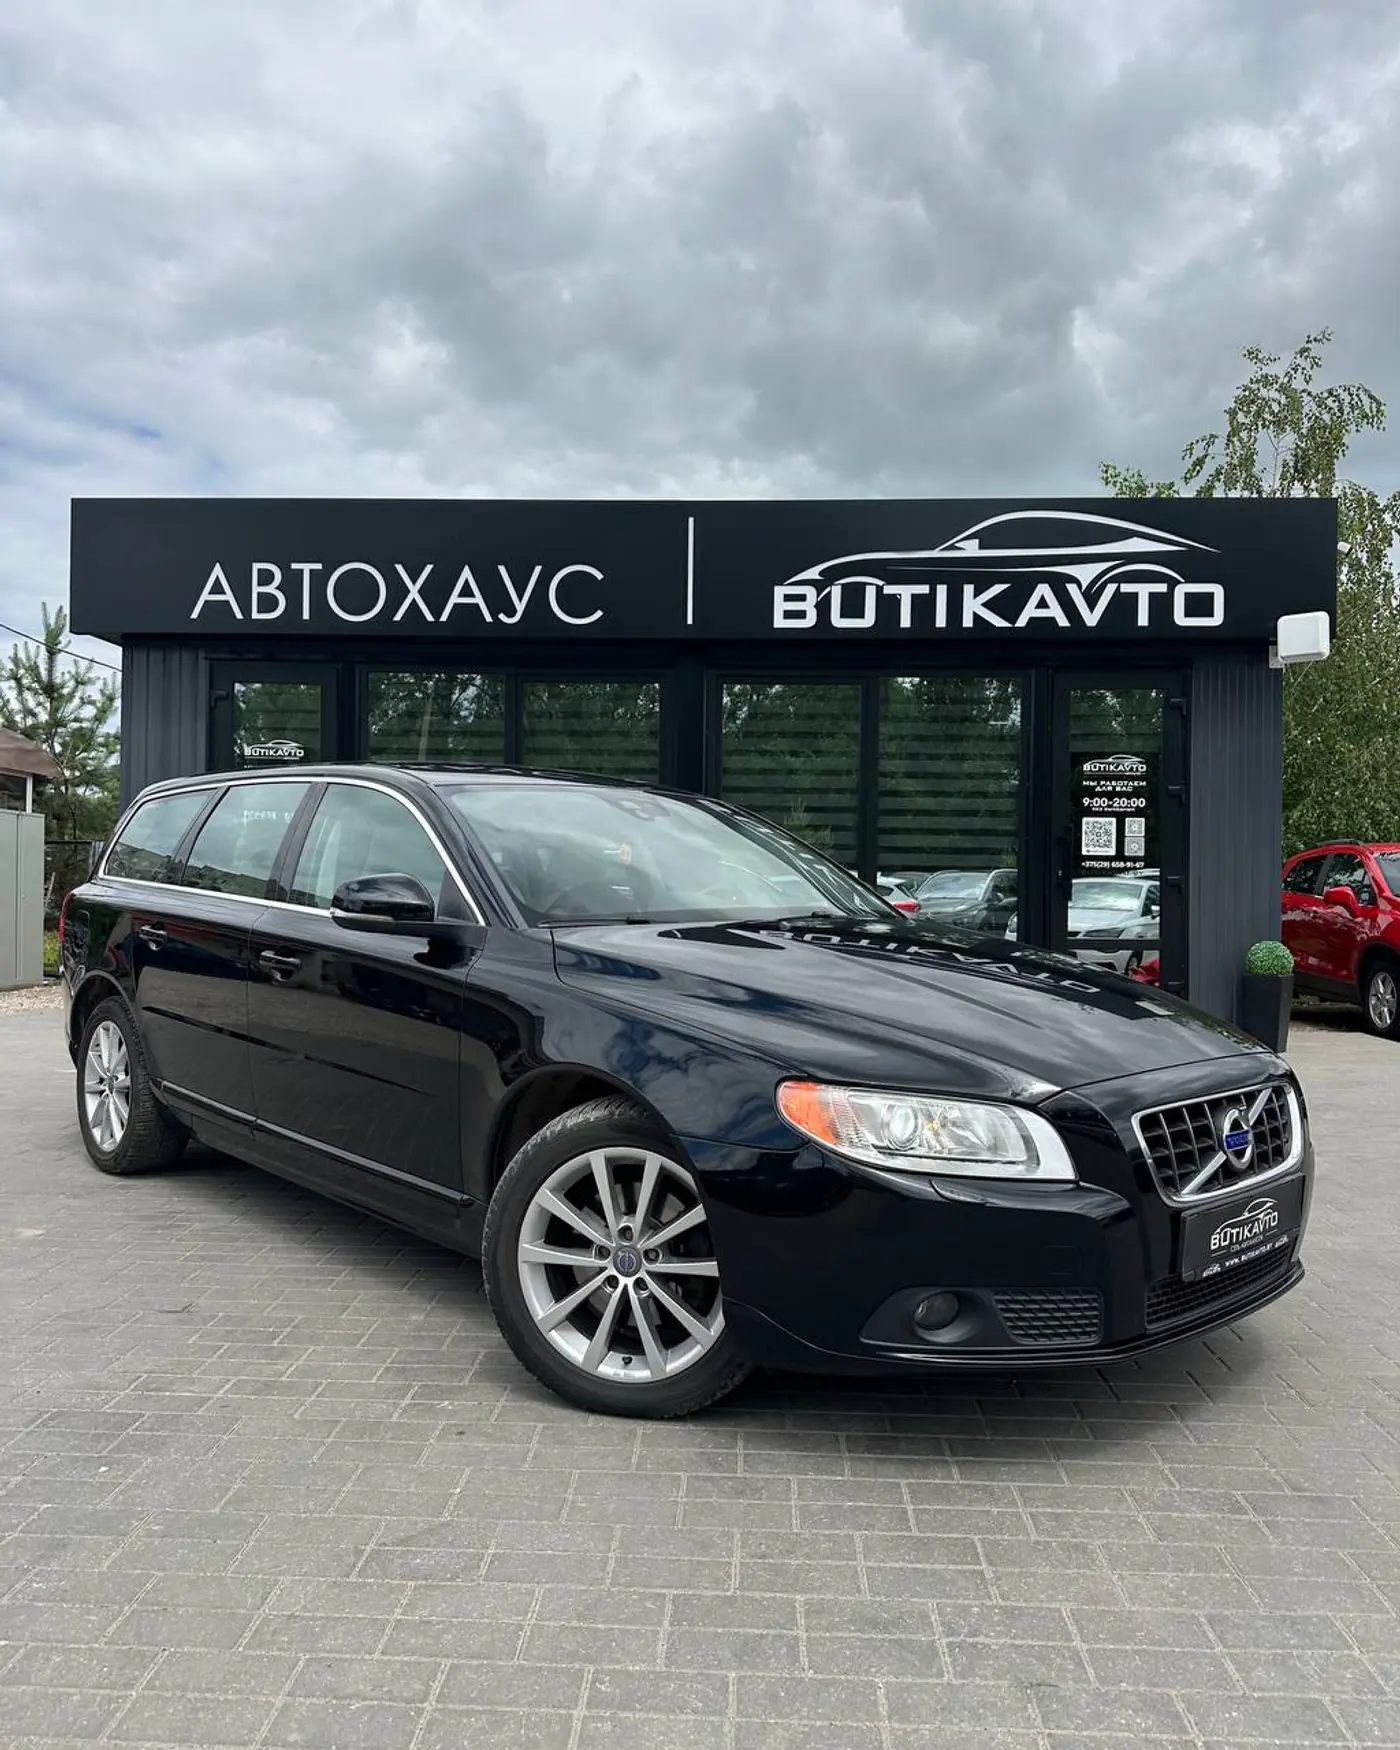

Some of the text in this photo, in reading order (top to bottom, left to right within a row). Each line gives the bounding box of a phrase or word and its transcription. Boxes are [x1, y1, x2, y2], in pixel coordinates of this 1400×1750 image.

[190, 562, 605, 625] АВТОХАУС
[773, 582, 1225, 629] BUTIKAVTO
[244, 748, 305, 757] BUTIKAVTO
[1082, 763, 1147, 772] BUTIKAVTO
[1082, 797, 1146, 808] 9:00-20:00
[1210, 1211, 1279, 1251] BUTIKAVTO
